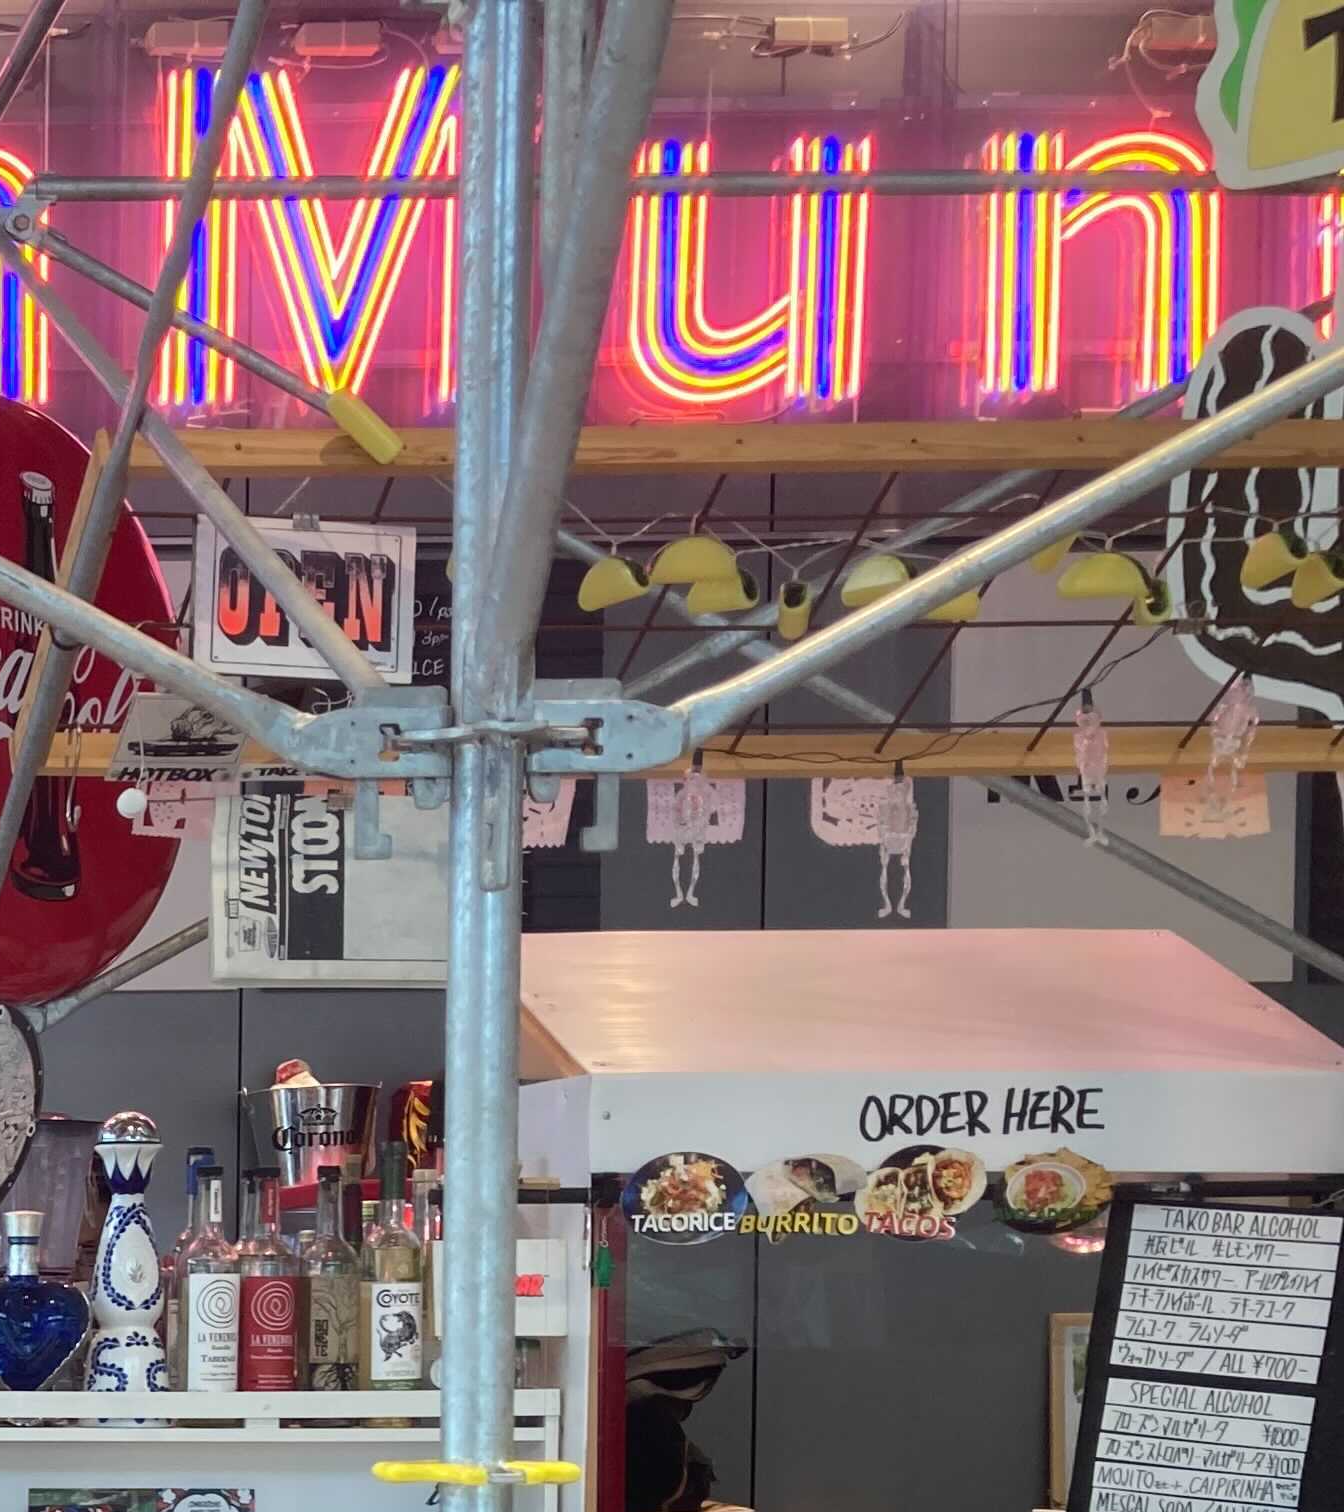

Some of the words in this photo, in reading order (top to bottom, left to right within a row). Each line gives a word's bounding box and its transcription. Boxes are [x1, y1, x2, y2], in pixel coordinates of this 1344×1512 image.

[117, 767, 217, 782] HOTBOX
[859, 1089, 991, 1142] ORDER
[1002, 1085, 1105, 1135] HERE
[630, 1211, 736, 1235] TACORICE
[738, 1211, 859, 1236] BURRITO
[862, 1209, 957, 1239] TACOS
[1160, 1207, 1210, 1231] TAKO
[1211, 1211, 1246, 1234] BAR
[1248, 1215, 1321, 1239] ALCOHOL
[375, 1288, 422, 1308] COYOTE
[1219, 1354, 1246, 1374] ALL
[1129, 1381, 1199, 1411] SPECIAL
[1203, 1388, 1273, 1417] ALCOHOL
